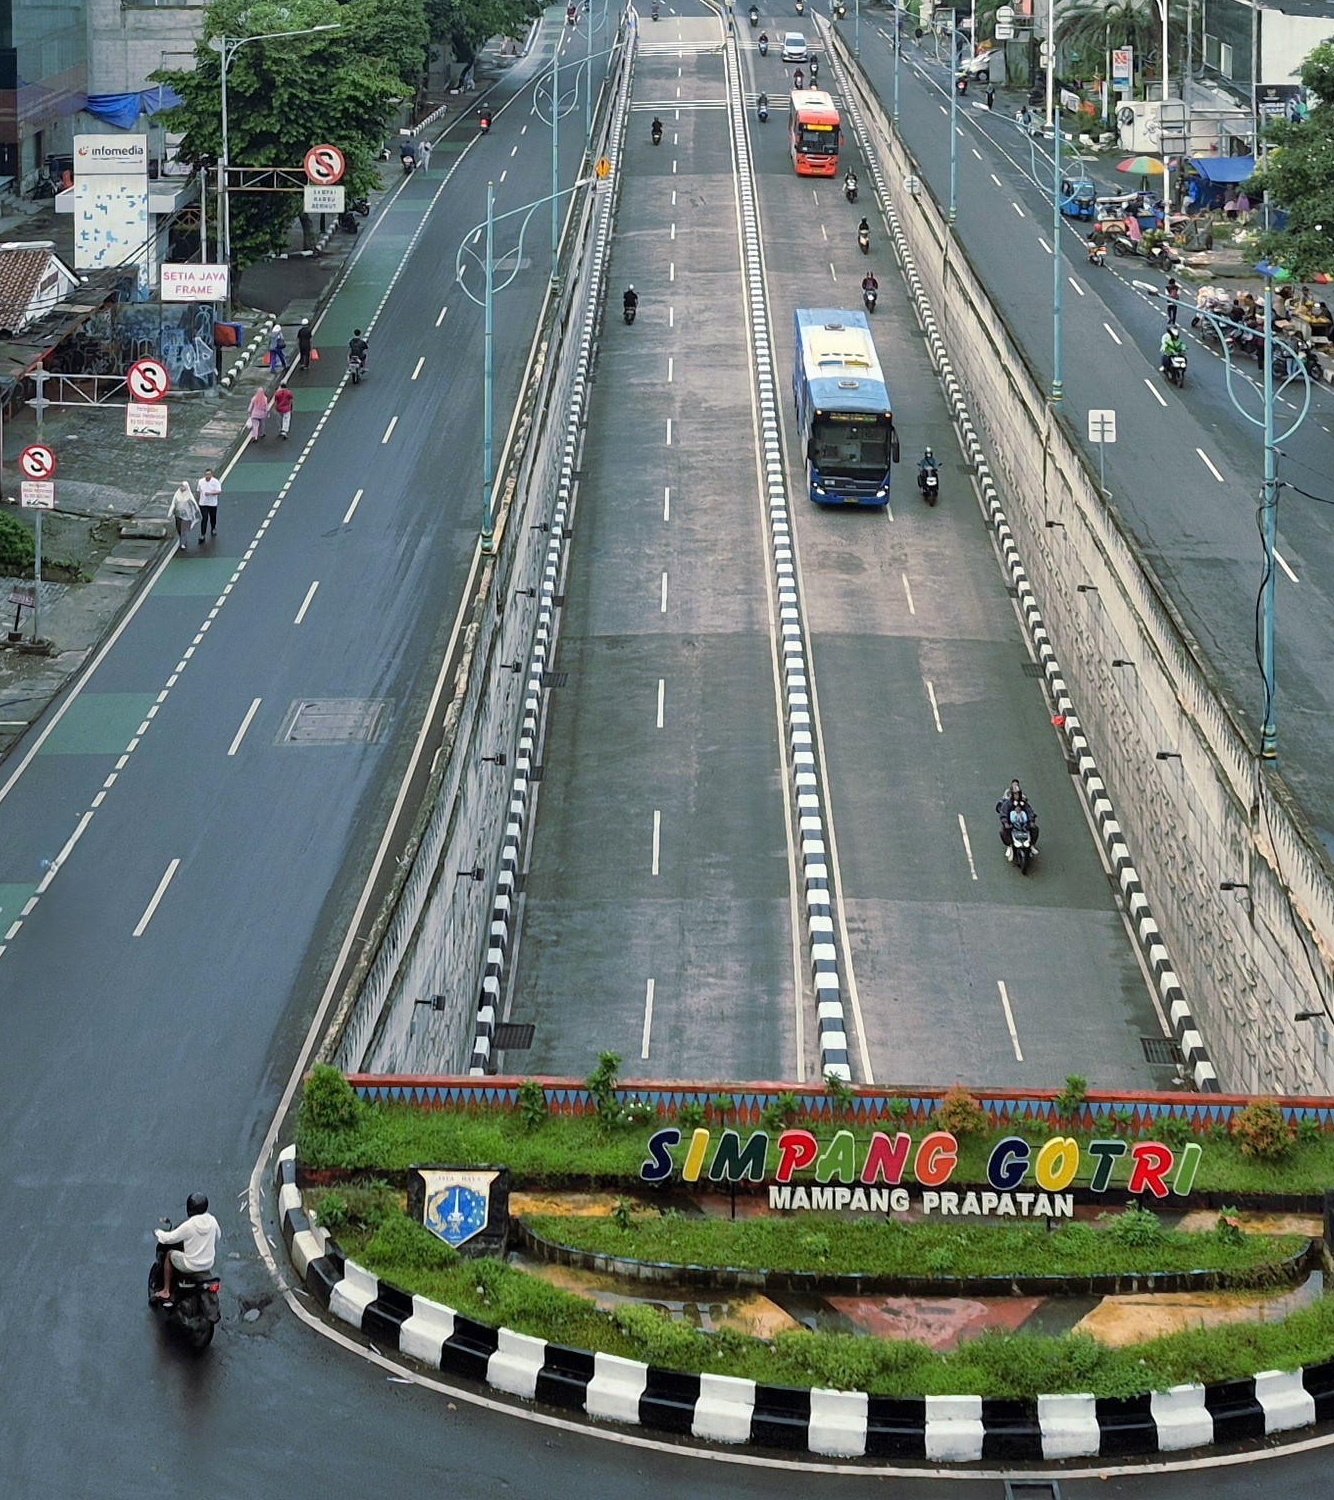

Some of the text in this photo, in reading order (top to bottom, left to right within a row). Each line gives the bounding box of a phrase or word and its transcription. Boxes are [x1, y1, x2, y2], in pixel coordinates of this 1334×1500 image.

[91, 145, 144, 156] infomedia
[163, 272, 195, 280] SETIA
[175, 285, 213, 294] FRAME
[640, 1128, 1202, 1198] SIMPANG GOTRI
[768, 1185, 1075, 1218] MAMPANG PRAPATAN
